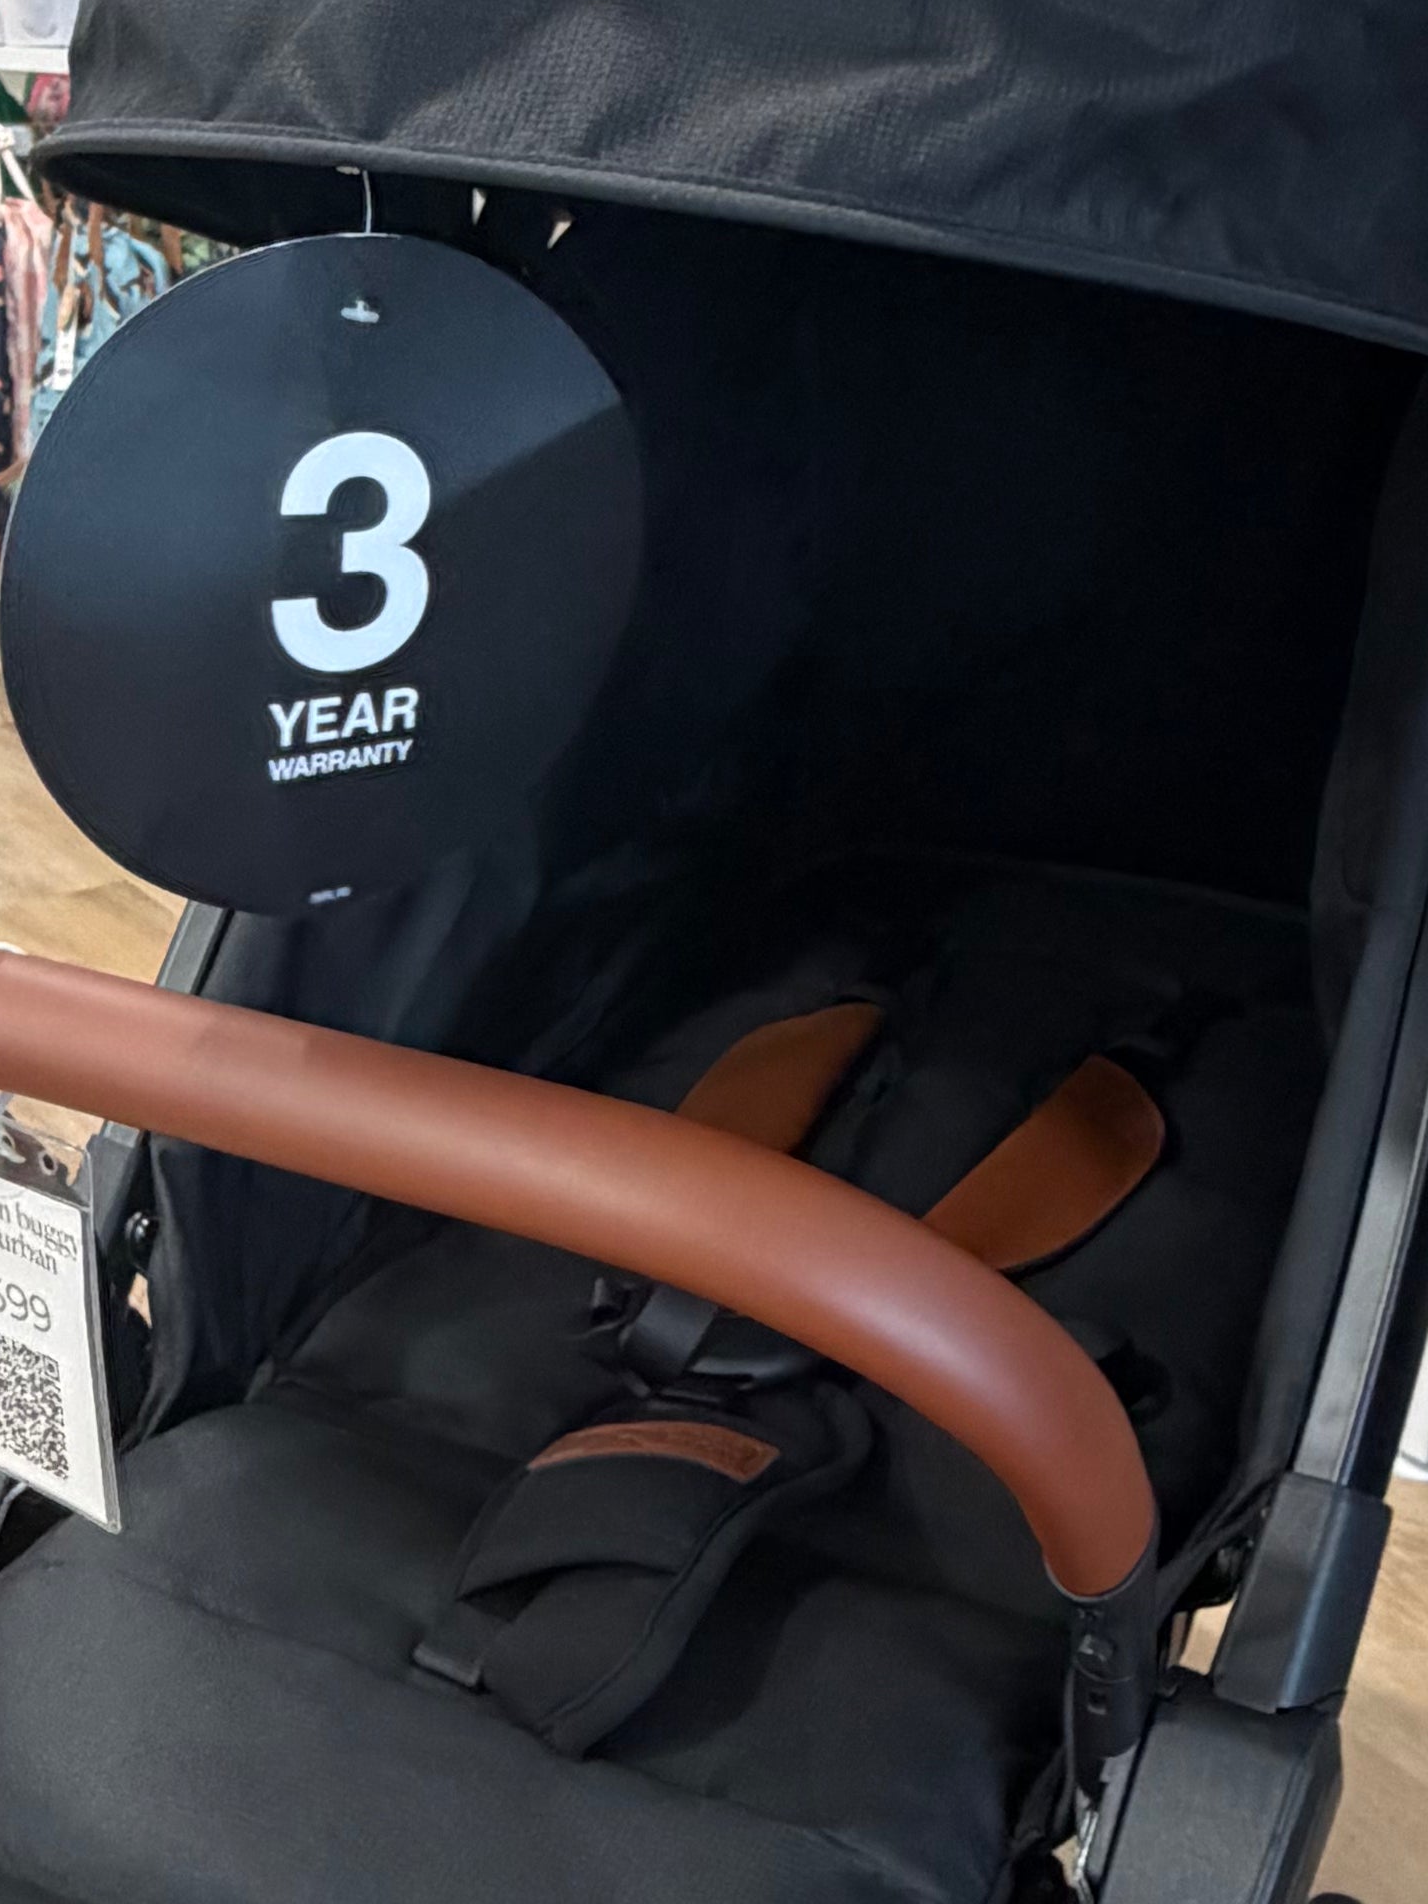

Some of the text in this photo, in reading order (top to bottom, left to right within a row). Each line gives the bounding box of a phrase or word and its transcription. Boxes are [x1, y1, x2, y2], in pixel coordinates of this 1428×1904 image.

[271, 431, 431, 673] 3
[268, 687, 419, 747] YEAR
[268, 739, 413, 781] WARRANTY
